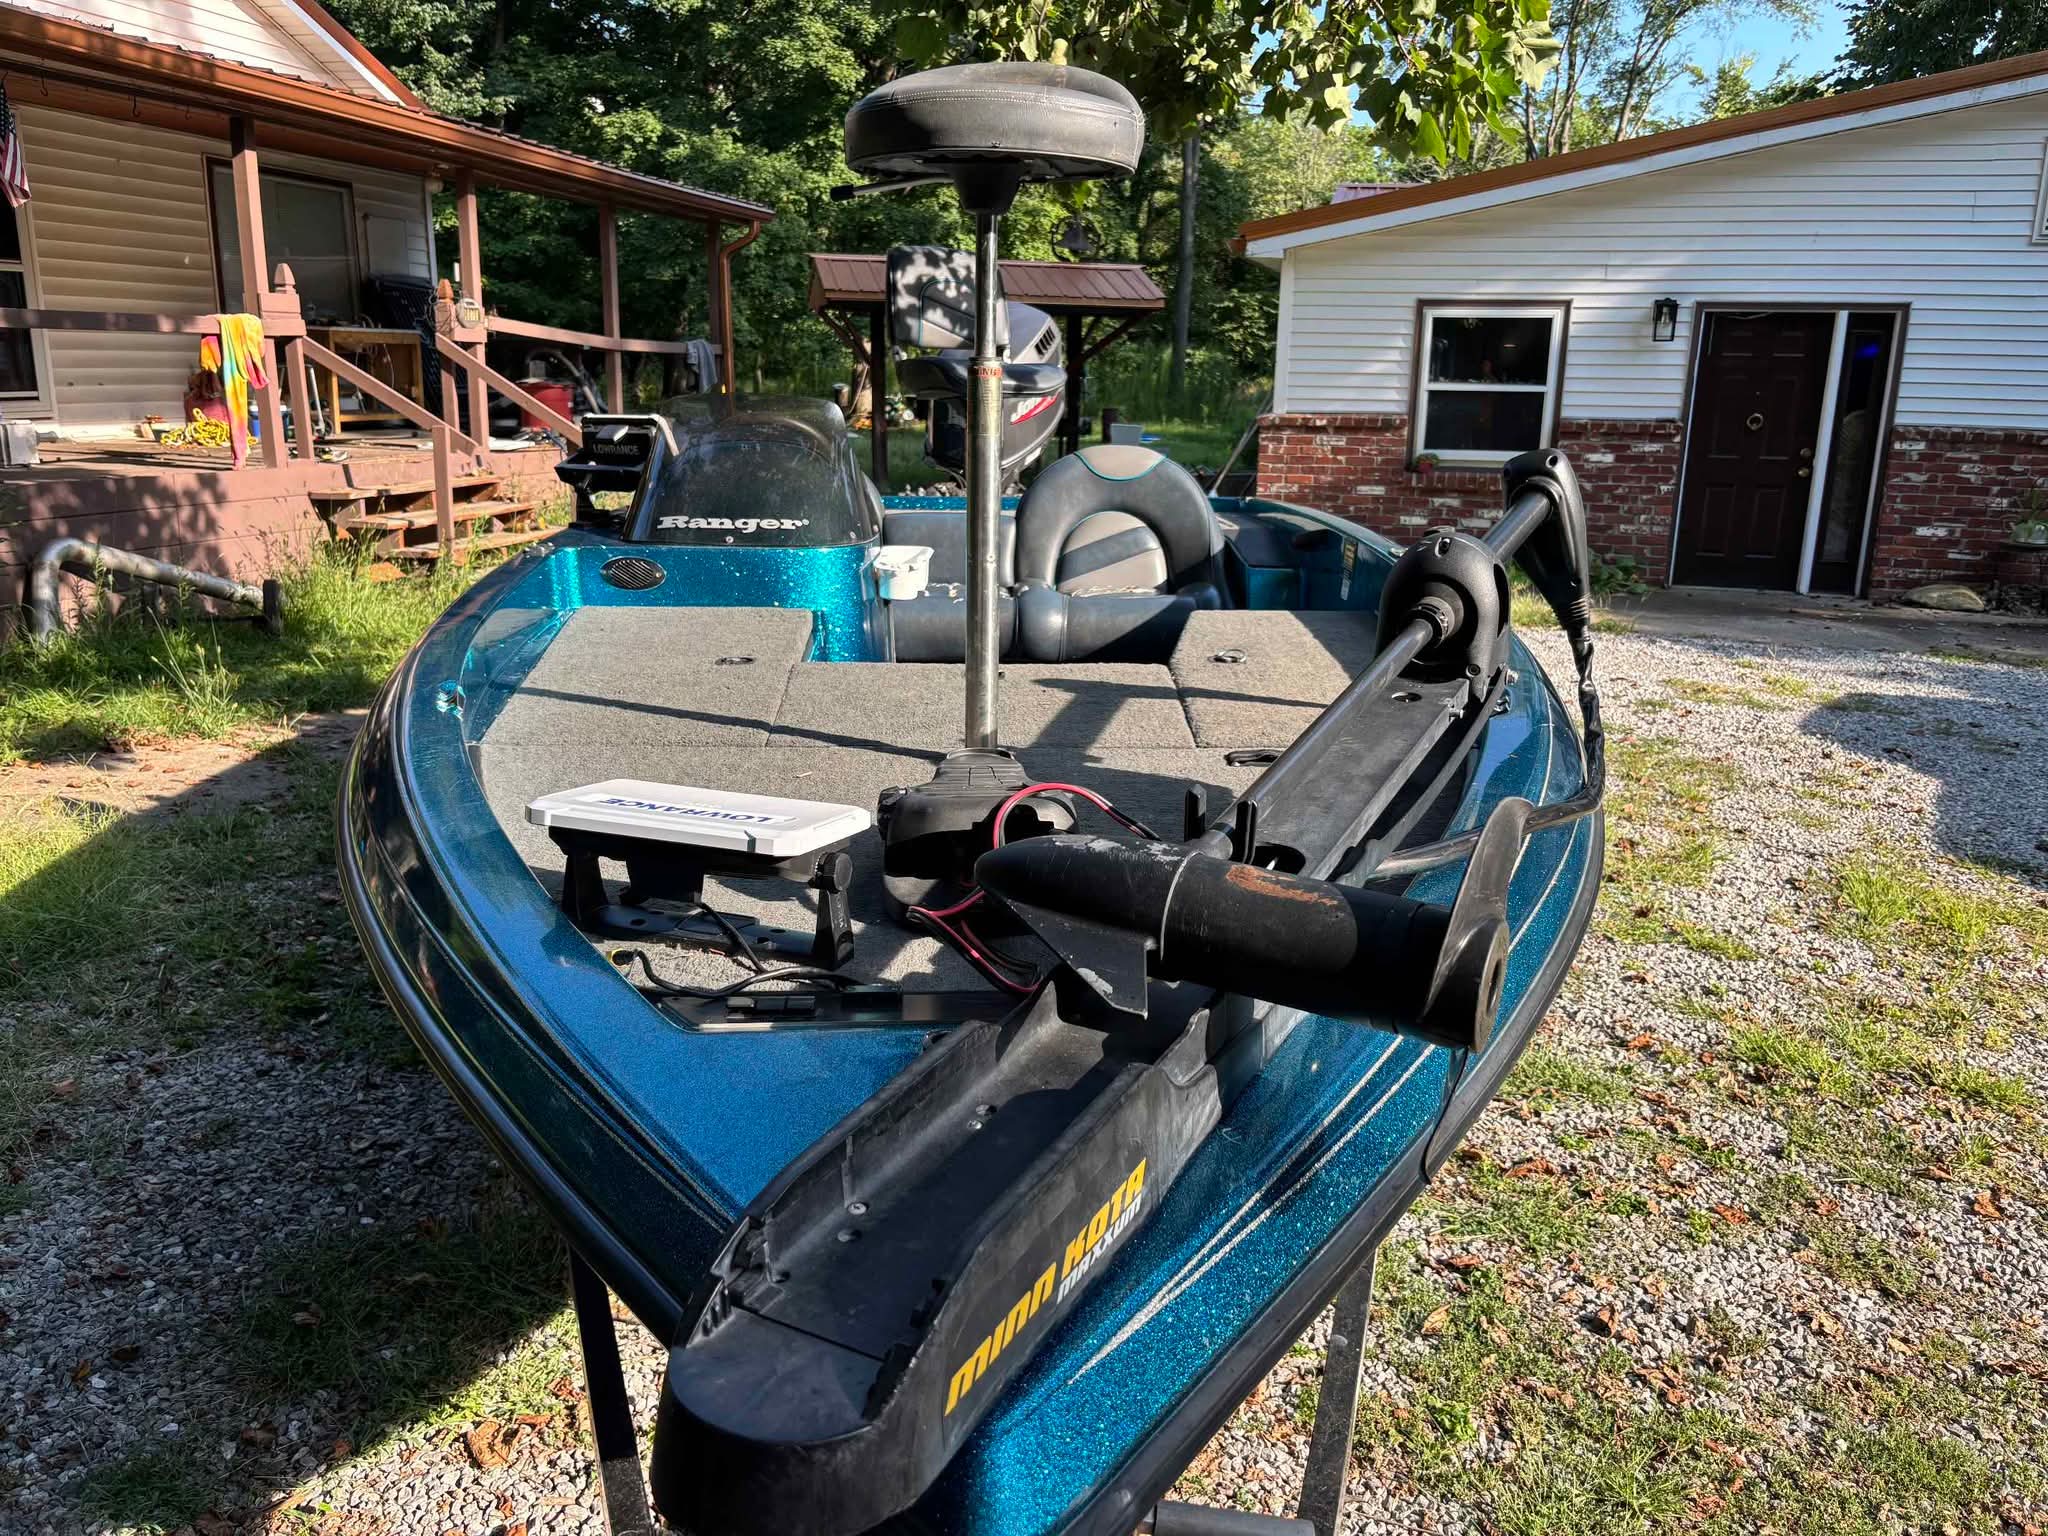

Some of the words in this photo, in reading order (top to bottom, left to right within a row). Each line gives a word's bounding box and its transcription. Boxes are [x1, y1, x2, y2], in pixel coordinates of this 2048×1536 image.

[592, 443, 640, 456] LOWRANCE
[600, 798, 774, 823] LOWRANCE
[1061, 1157, 1147, 1281] KOTA
